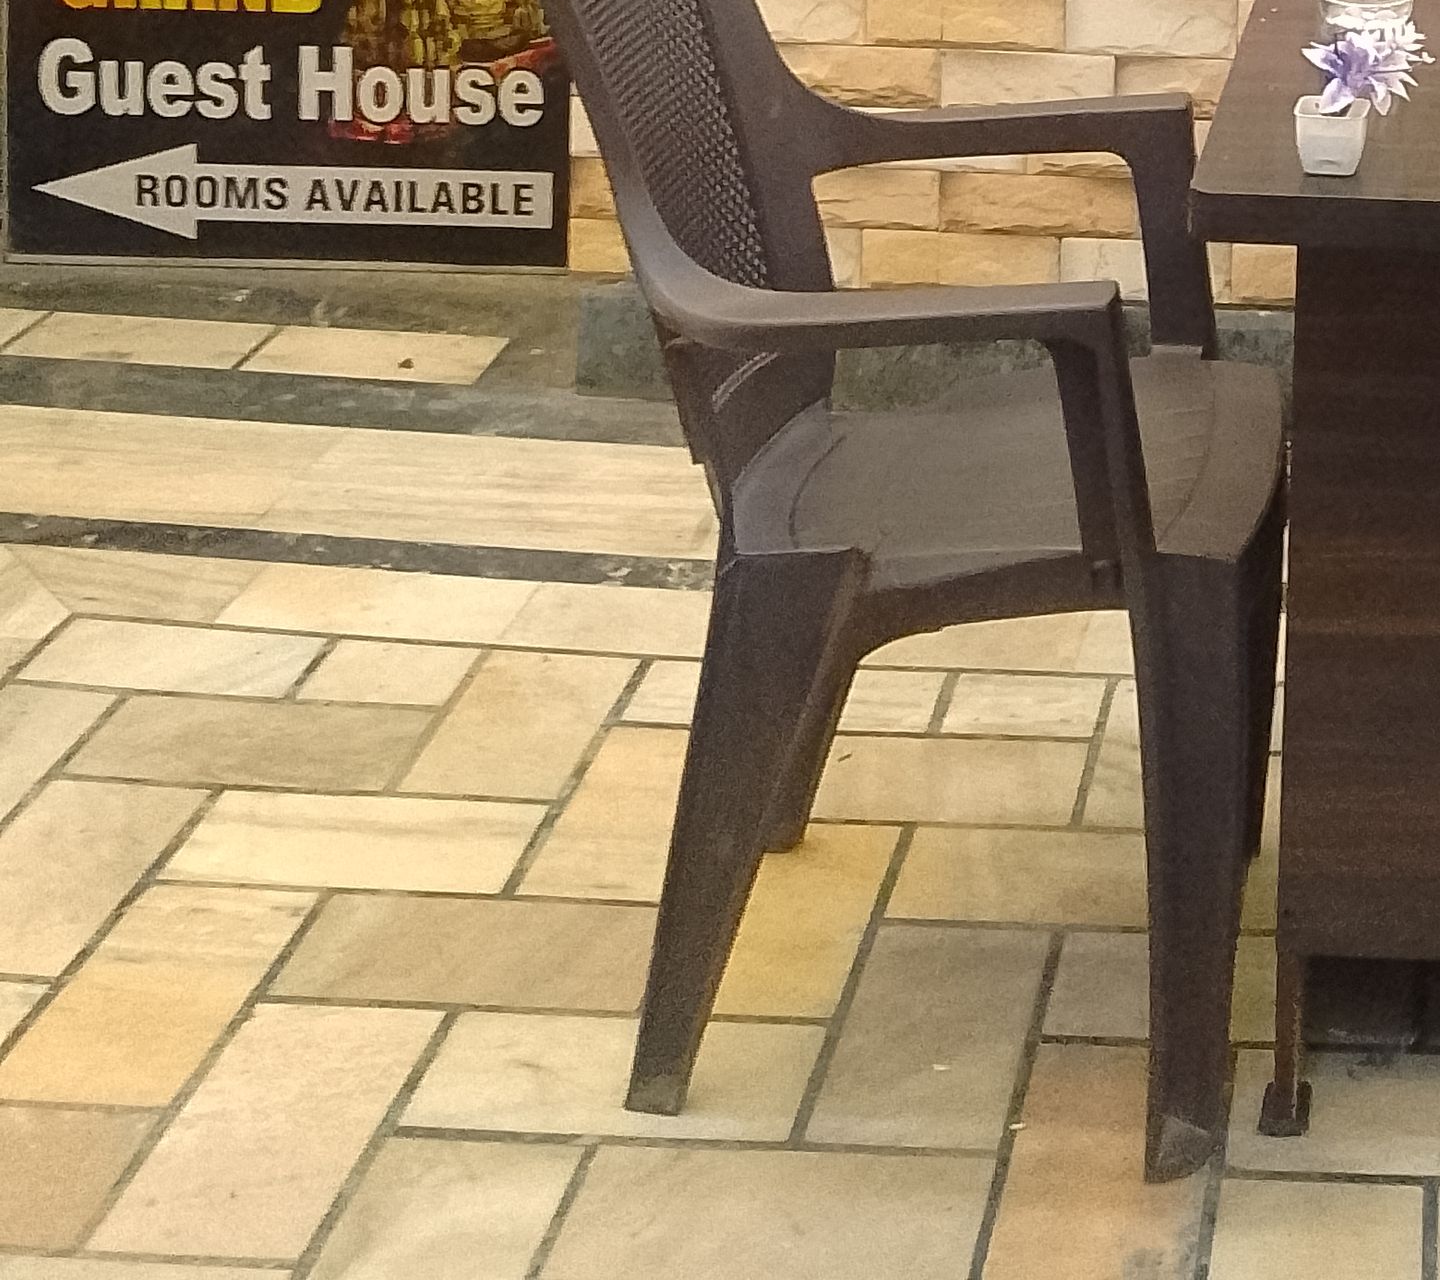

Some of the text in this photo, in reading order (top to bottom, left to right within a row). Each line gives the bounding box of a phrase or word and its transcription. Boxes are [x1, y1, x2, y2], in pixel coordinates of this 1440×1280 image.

[37, 38, 545, 127] Guest House
[136, 173, 535, 217] ROOMS AVAILABLE
